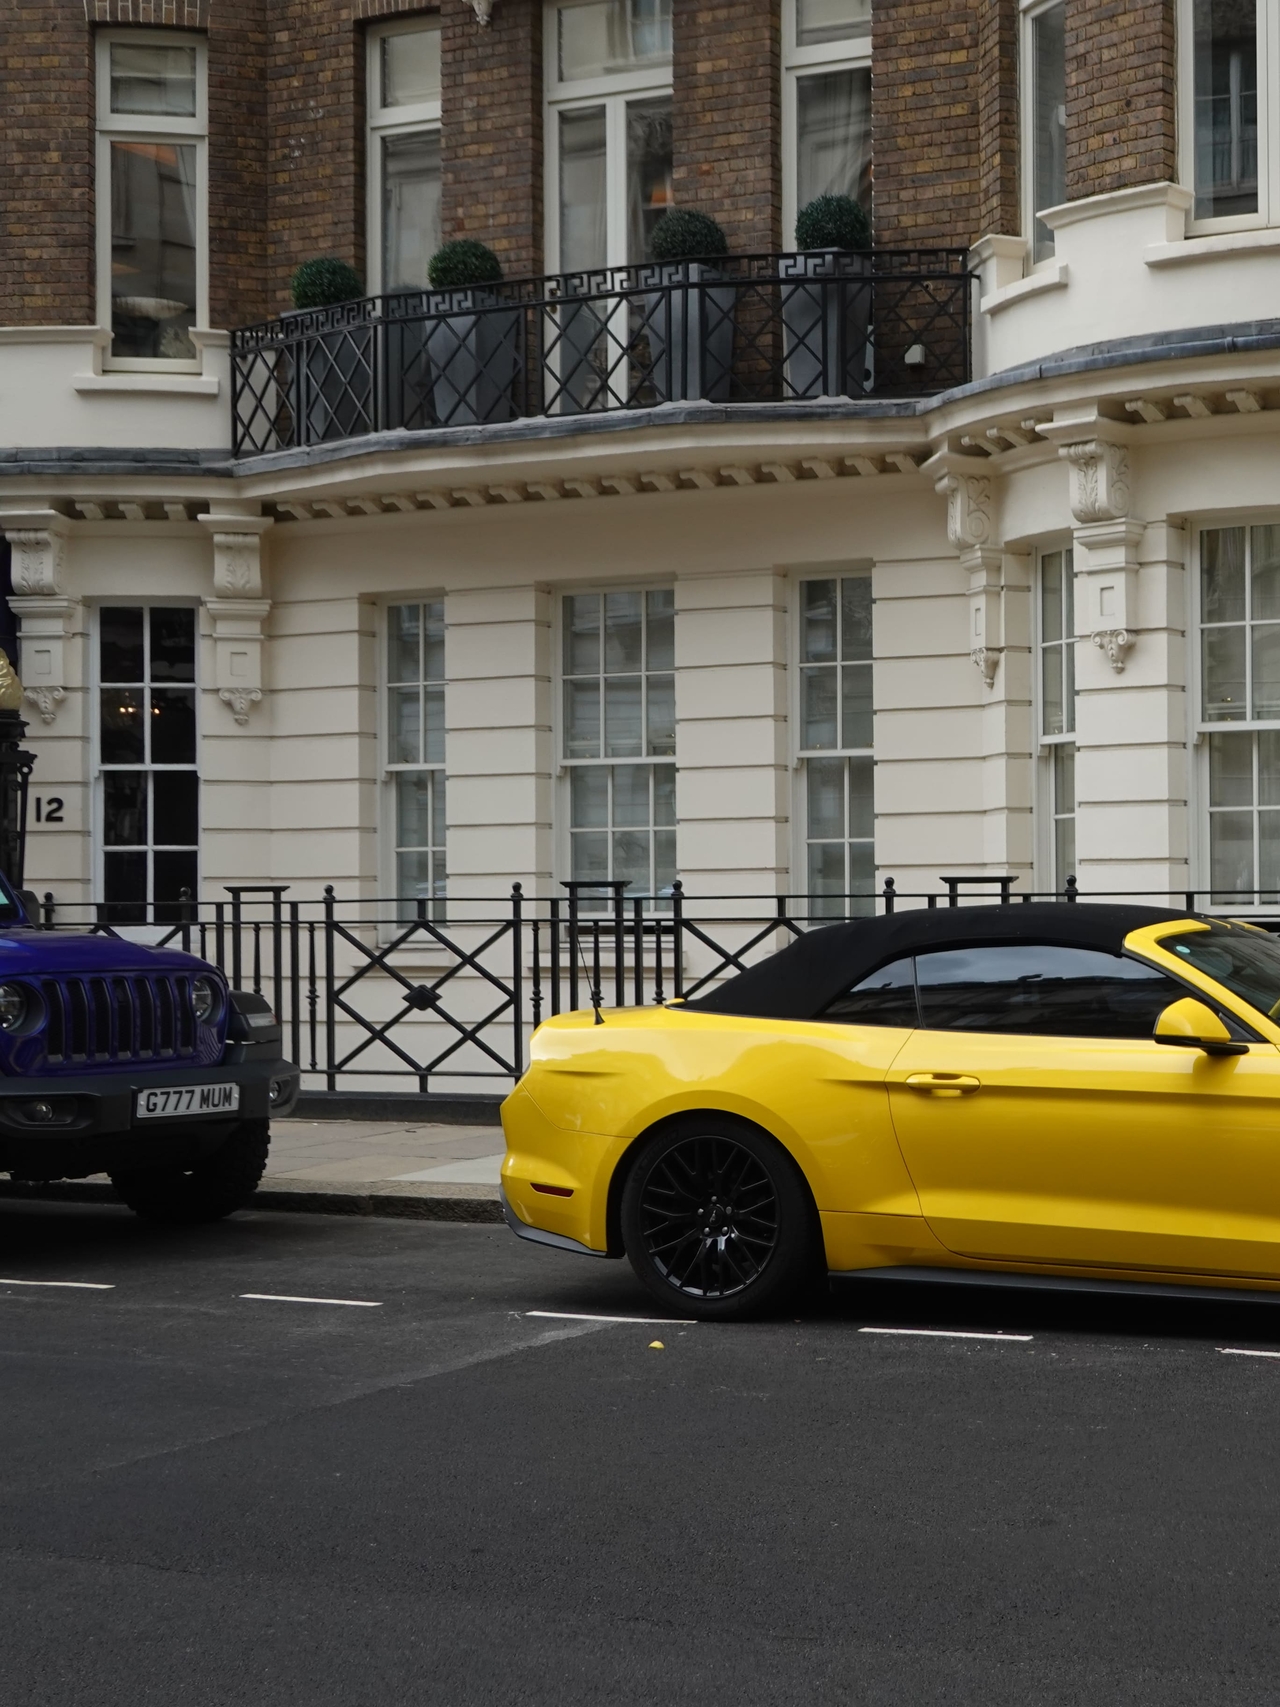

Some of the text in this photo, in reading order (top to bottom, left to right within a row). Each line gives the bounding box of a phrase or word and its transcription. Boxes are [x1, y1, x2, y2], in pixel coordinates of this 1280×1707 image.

[36, 797, 64, 822] 12
[146, 1086, 233, 1113] G777 MUM
